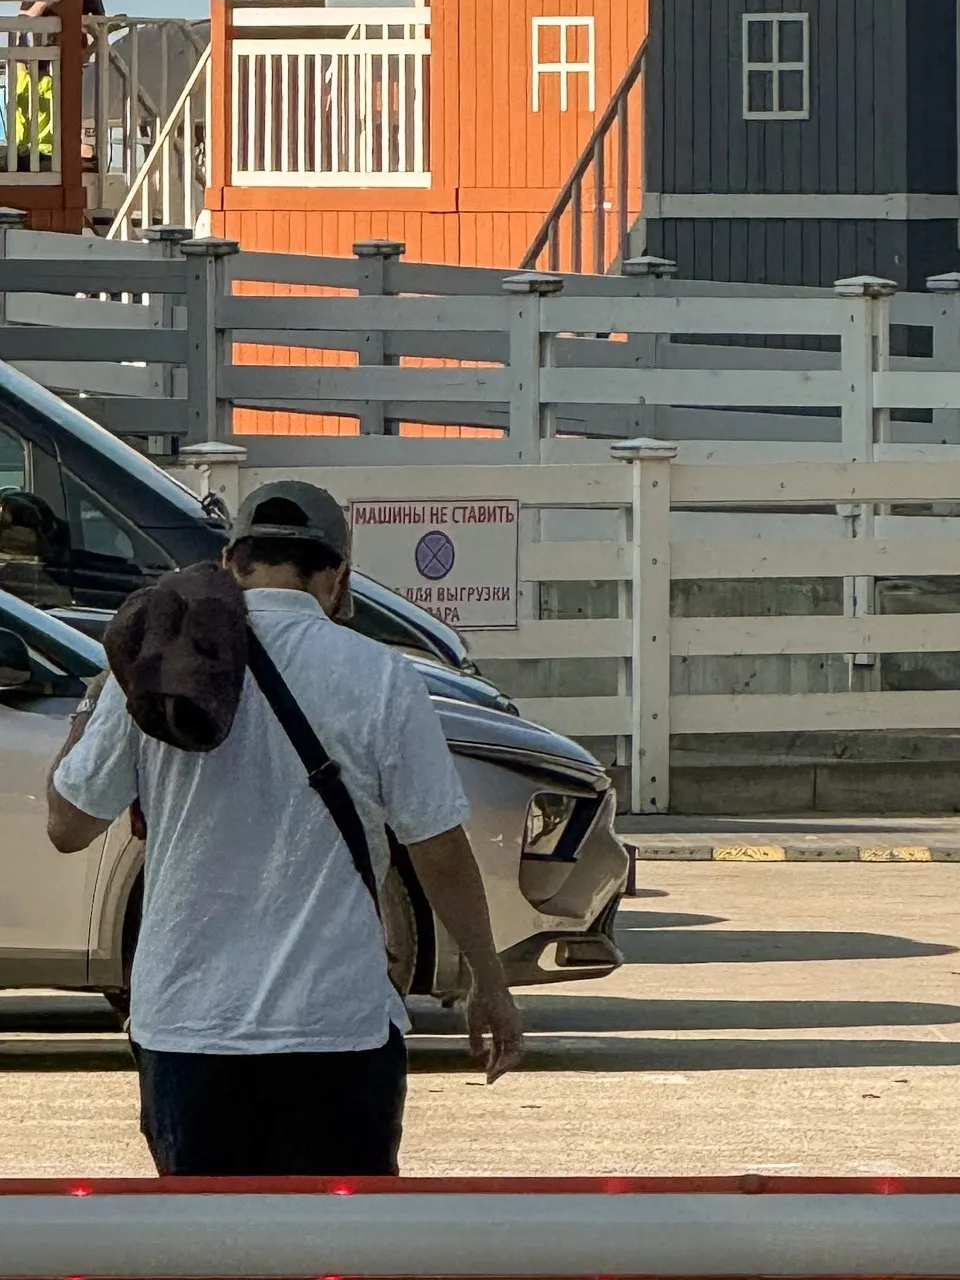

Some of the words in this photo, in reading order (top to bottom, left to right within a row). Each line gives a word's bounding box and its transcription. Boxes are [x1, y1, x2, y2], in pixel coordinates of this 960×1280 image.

[355, 506, 425, 525] МАШИНЫ
[429, 506, 448, 524] НЕ
[452, 505, 515, 524] СТАВИТЬ
[437, 586, 510, 602] ВЫГРУЗКИ
